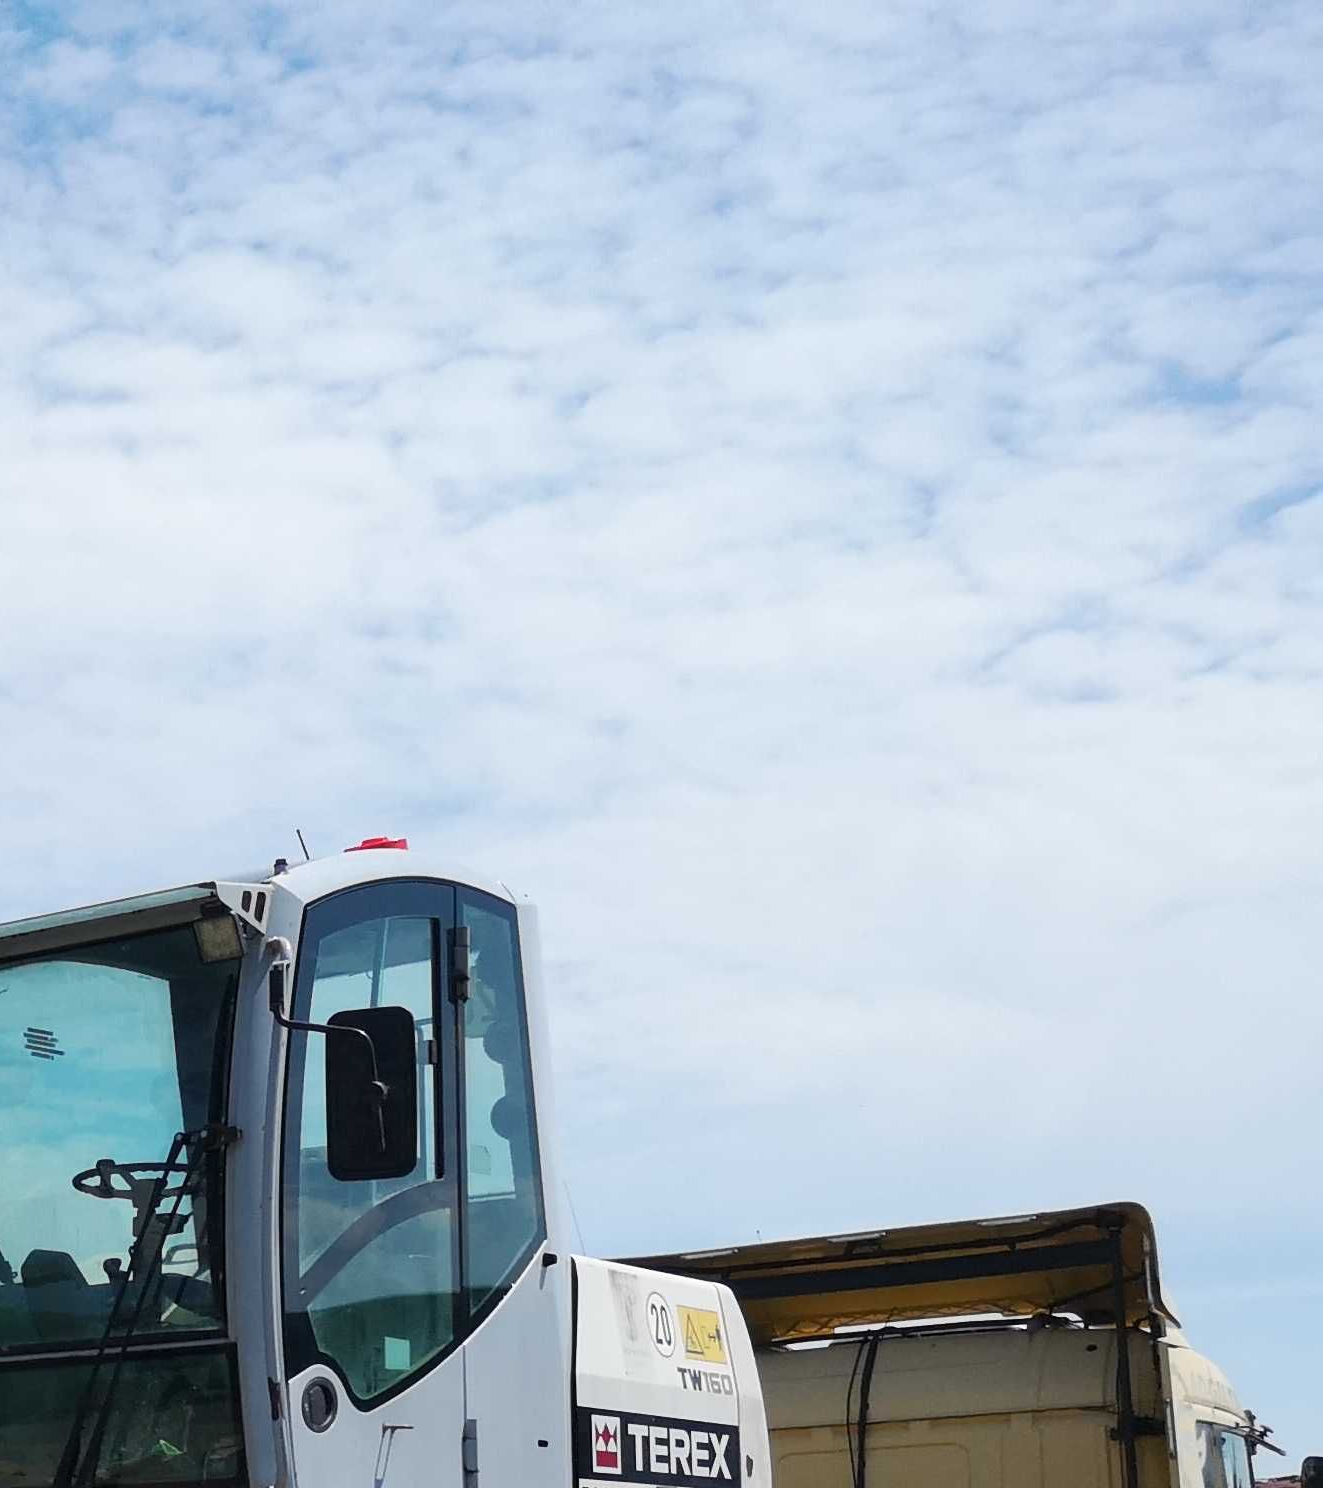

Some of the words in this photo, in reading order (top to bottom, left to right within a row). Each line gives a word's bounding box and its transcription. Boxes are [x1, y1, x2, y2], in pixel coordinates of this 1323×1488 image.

[650, 1303, 672, 1347] 20
[676, 1366, 733, 1395] TW160
[627, 1423, 733, 1481] TEREX
